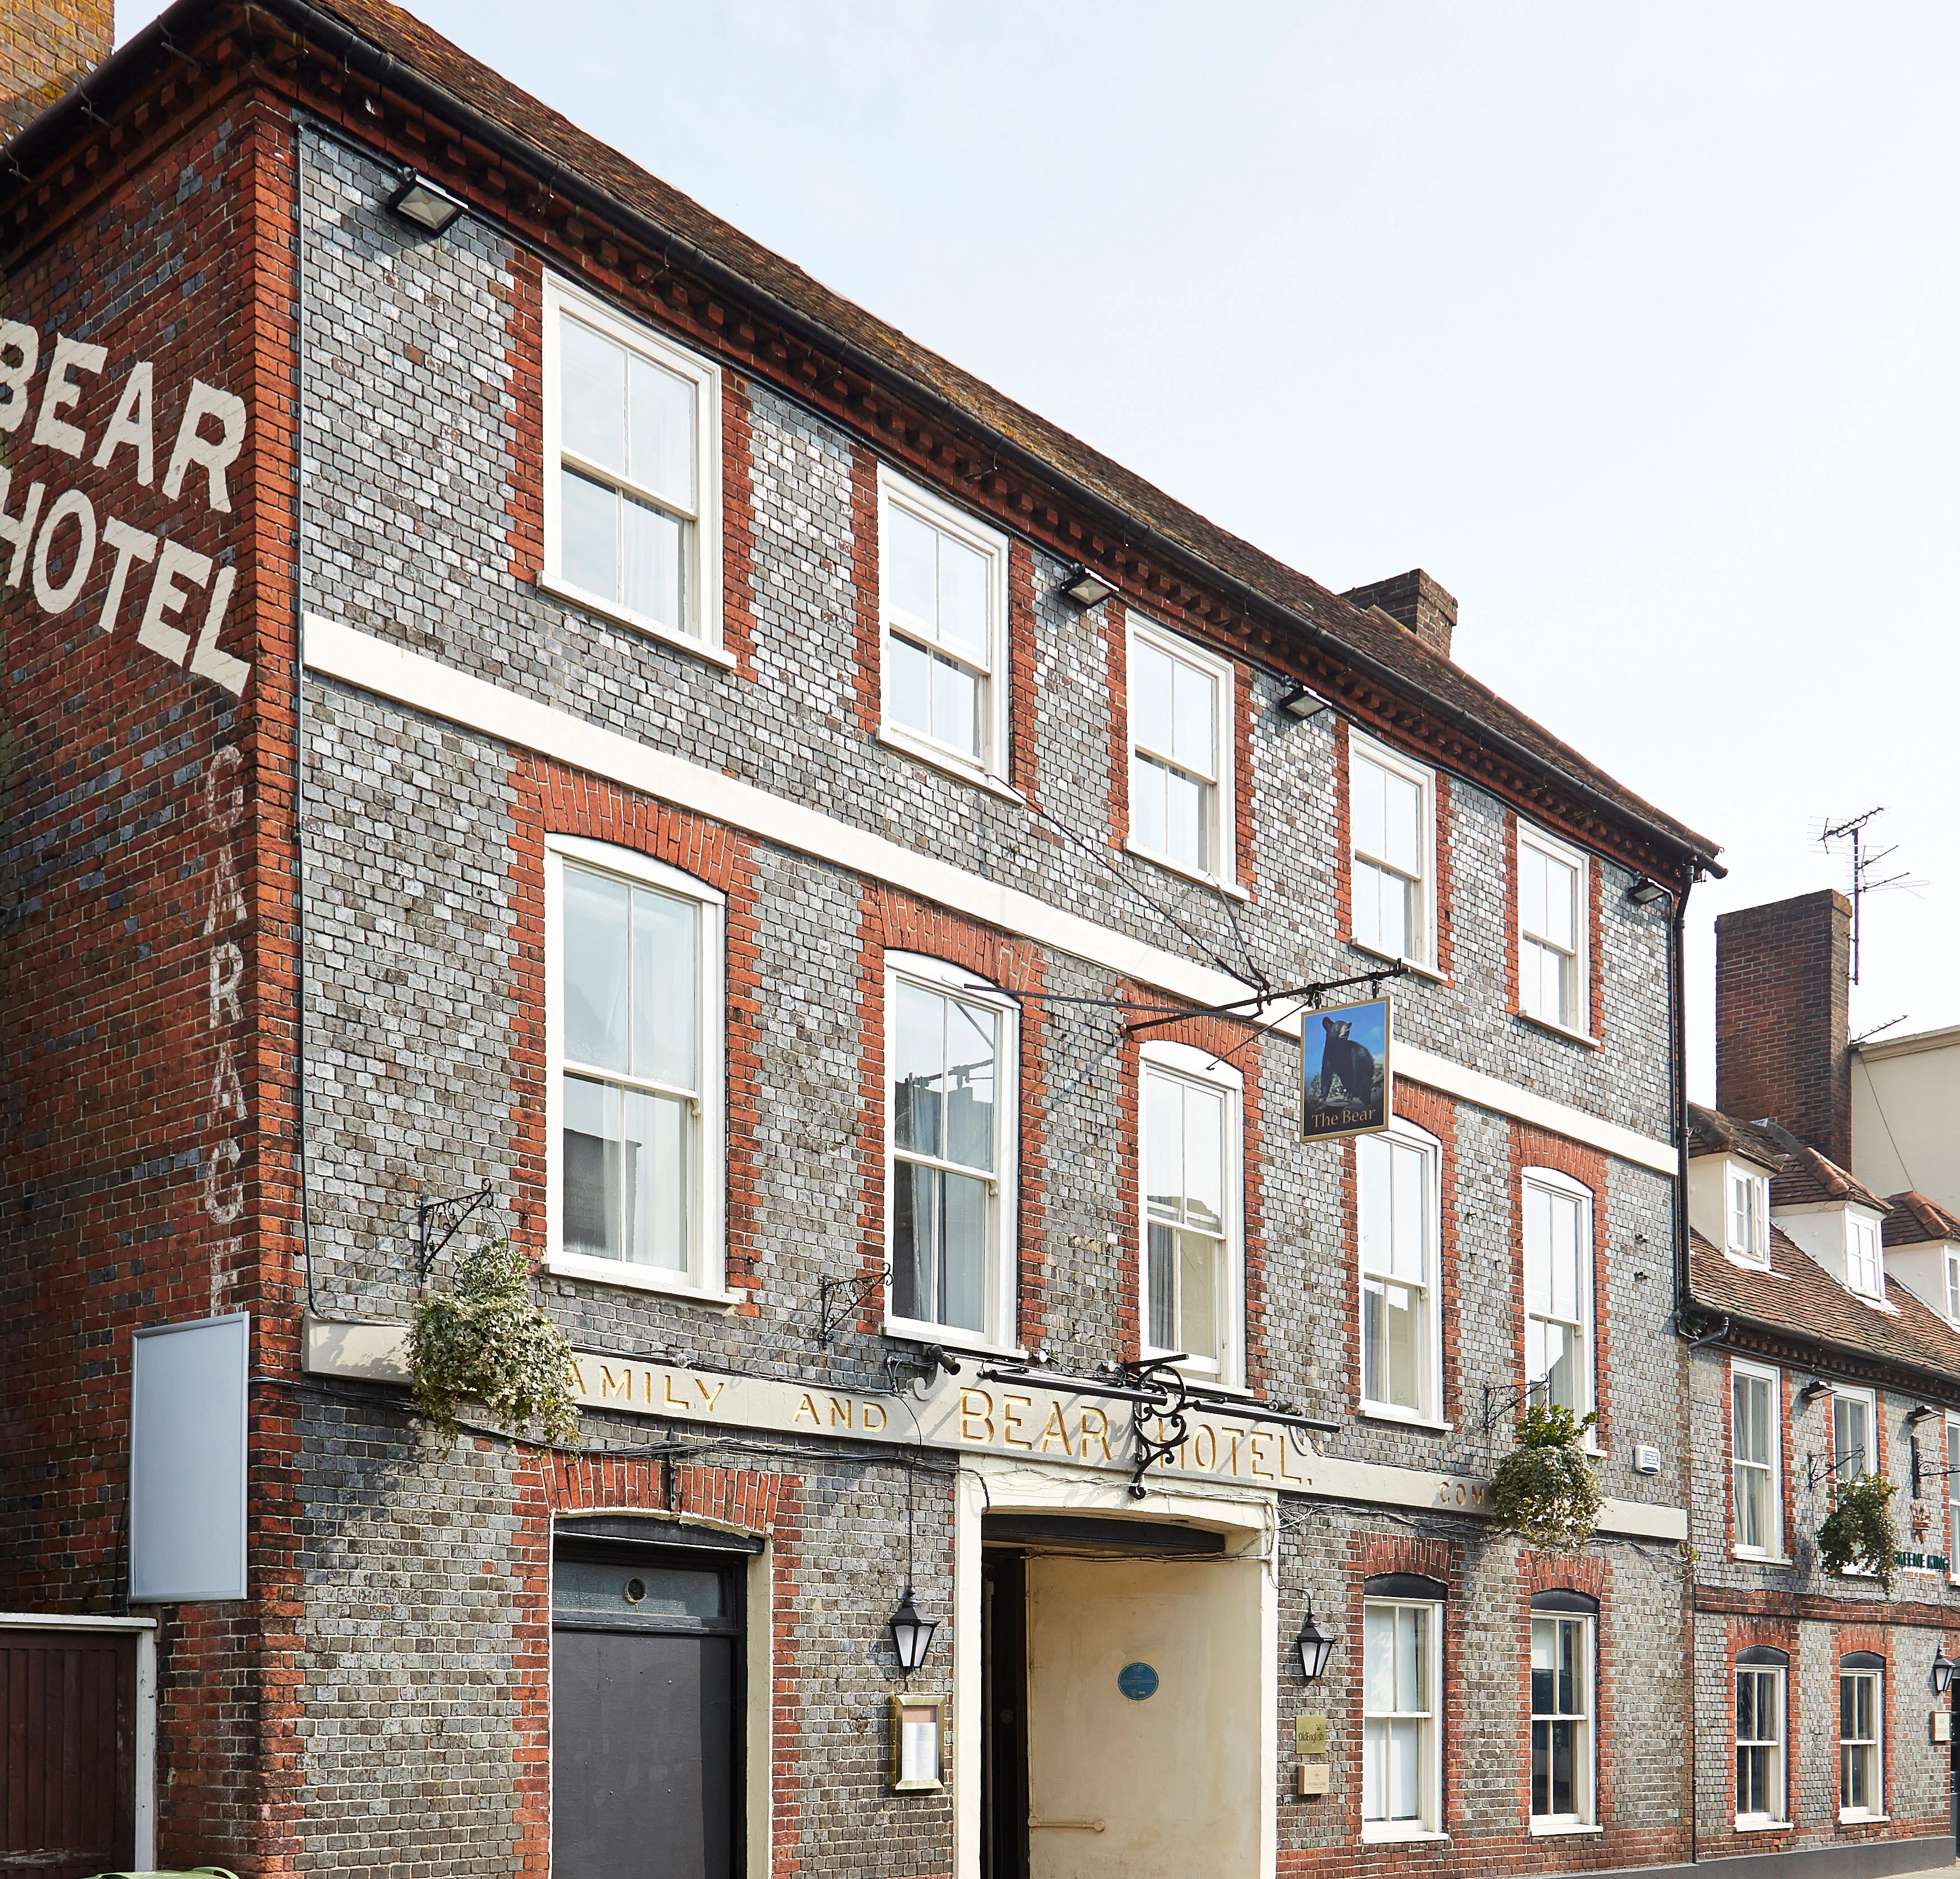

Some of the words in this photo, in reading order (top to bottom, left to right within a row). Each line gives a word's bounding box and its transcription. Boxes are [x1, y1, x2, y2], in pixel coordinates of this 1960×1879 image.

[0, 318, 246, 513] BEAR
[0, 464, 251, 697] HOTEL
[1312, 1113, 1339, 1128] The
[1343, 1109, 1375, 1123] Bear
[570, 1362, 724, 1412] AMILY
[793, 1394, 887, 1432] AND
[960, 1387, 1111, 1461] BEAR
[1926, 1554, 1949, 1571] KING
[1298, 1732, 1324, 1743] OldEnglsh
